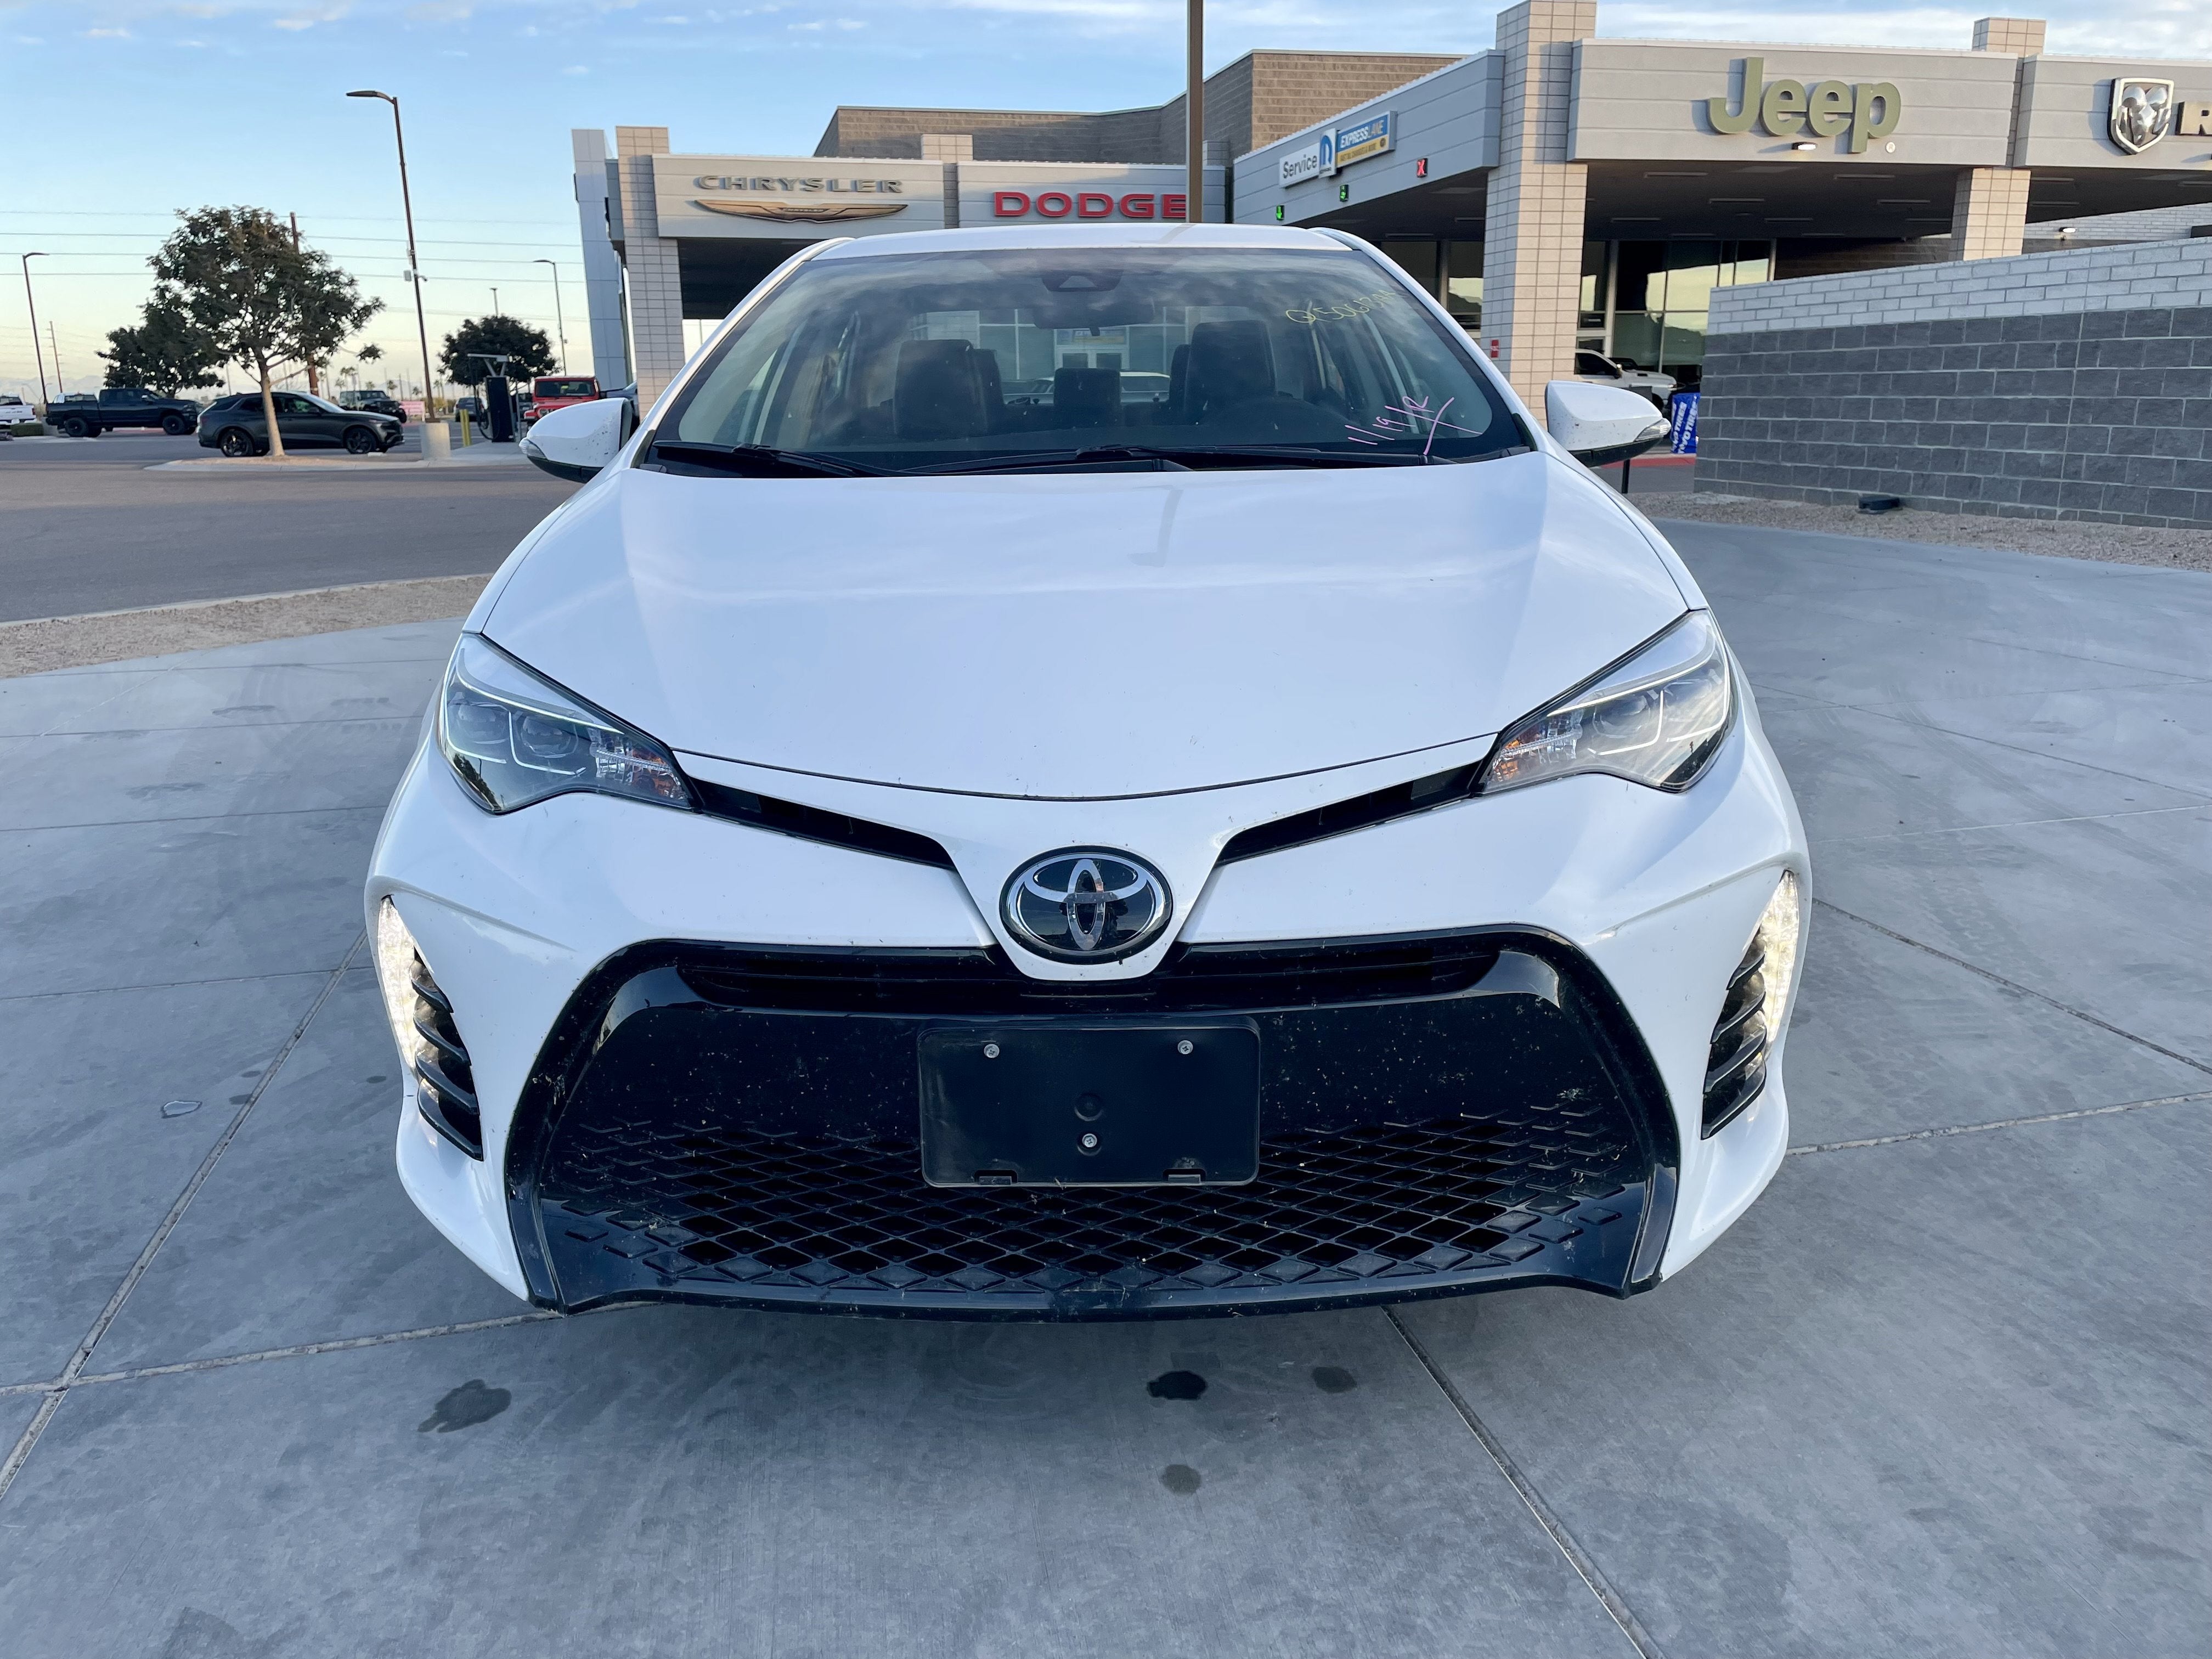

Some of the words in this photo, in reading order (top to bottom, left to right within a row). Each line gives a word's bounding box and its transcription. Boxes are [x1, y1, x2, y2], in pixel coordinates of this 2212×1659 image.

[1708, 57, 1901, 154] Jeep
[1283, 154, 1317, 179] Service
[697, 175, 902, 193] CHRYSLER
[994, 191, 1187, 218] DODGE
